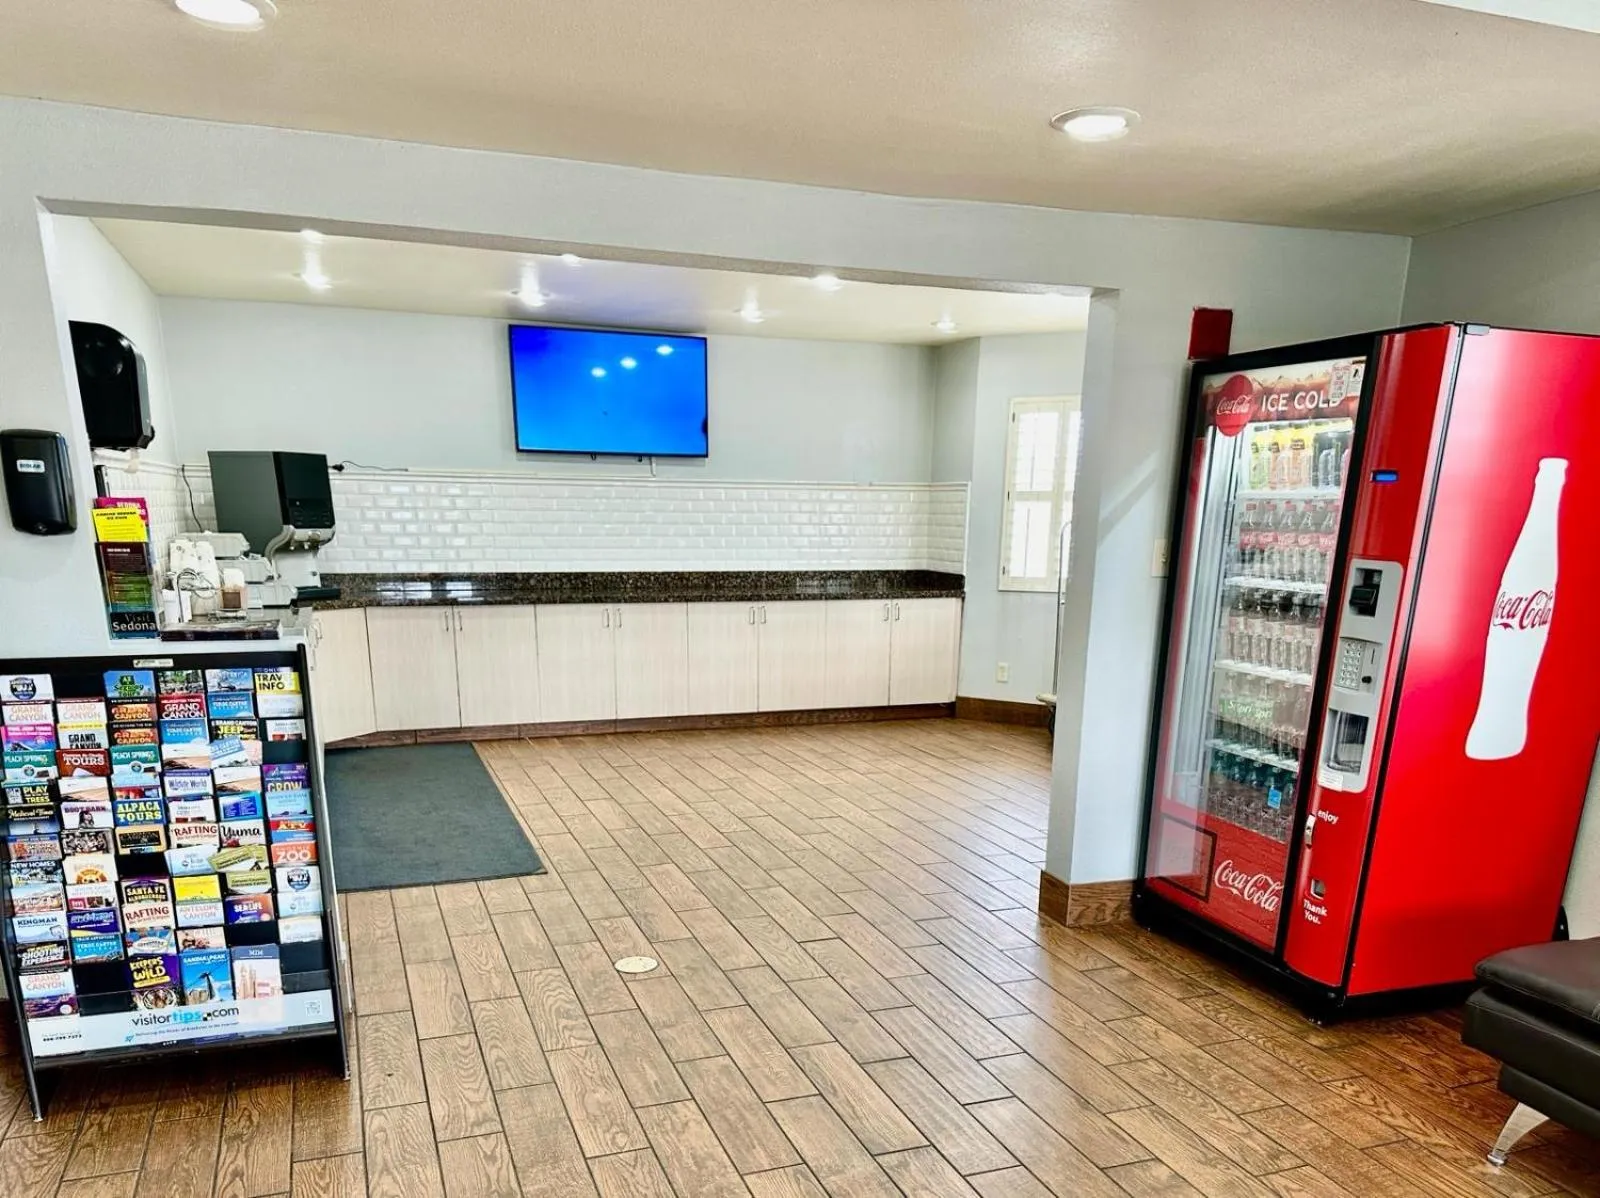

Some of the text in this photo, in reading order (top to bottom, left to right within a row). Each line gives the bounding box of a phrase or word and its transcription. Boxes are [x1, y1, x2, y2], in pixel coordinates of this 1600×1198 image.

[1261, 393, 1289, 412] ICE
[124, 613, 151, 622] Visit
[112, 621, 157, 632] Sedona
[256, 673, 283, 682] TRAV
[259, 682, 286, 691] INFO
[11, 705, 43, 713] GRAND
[164, 702, 200, 713] GRAND
[9, 713, 48, 722] CANYON
[114, 711, 149, 719] CANYON
[162, 710, 204, 720] CANYON
[218, 726, 243, 734] JEEP
[68, 733, 96, 742] GRAND
[65, 756, 105, 766] TOURS
[23, 785, 48, 794] PLAY
[267, 781, 302, 792] GROW
[117, 801, 161, 812] ALPACA
[117, 811, 162, 822] TOURS
[1317, 809, 1339, 825] enjoy
[174, 826, 218, 837] RAFTING
[221, 826, 262, 839] Yuma
[276, 851, 311, 861] ZOO
[126, 886, 166, 896] SANTA FE
[1215, 859, 1285, 912] Coca-Cola
[234, 902, 263, 913] SEA LIFE
[1303, 899, 1328, 917] Thank
[125, 907, 170, 921] RAFTING
[17, 917, 58, 926] KINGMAN
[22, 946, 65, 959] SHOOTING
[21, 955, 65, 967] EXPERIENCE
[129, 957, 164, 971] KEEPERS
[133, 966, 166, 980] WILD
